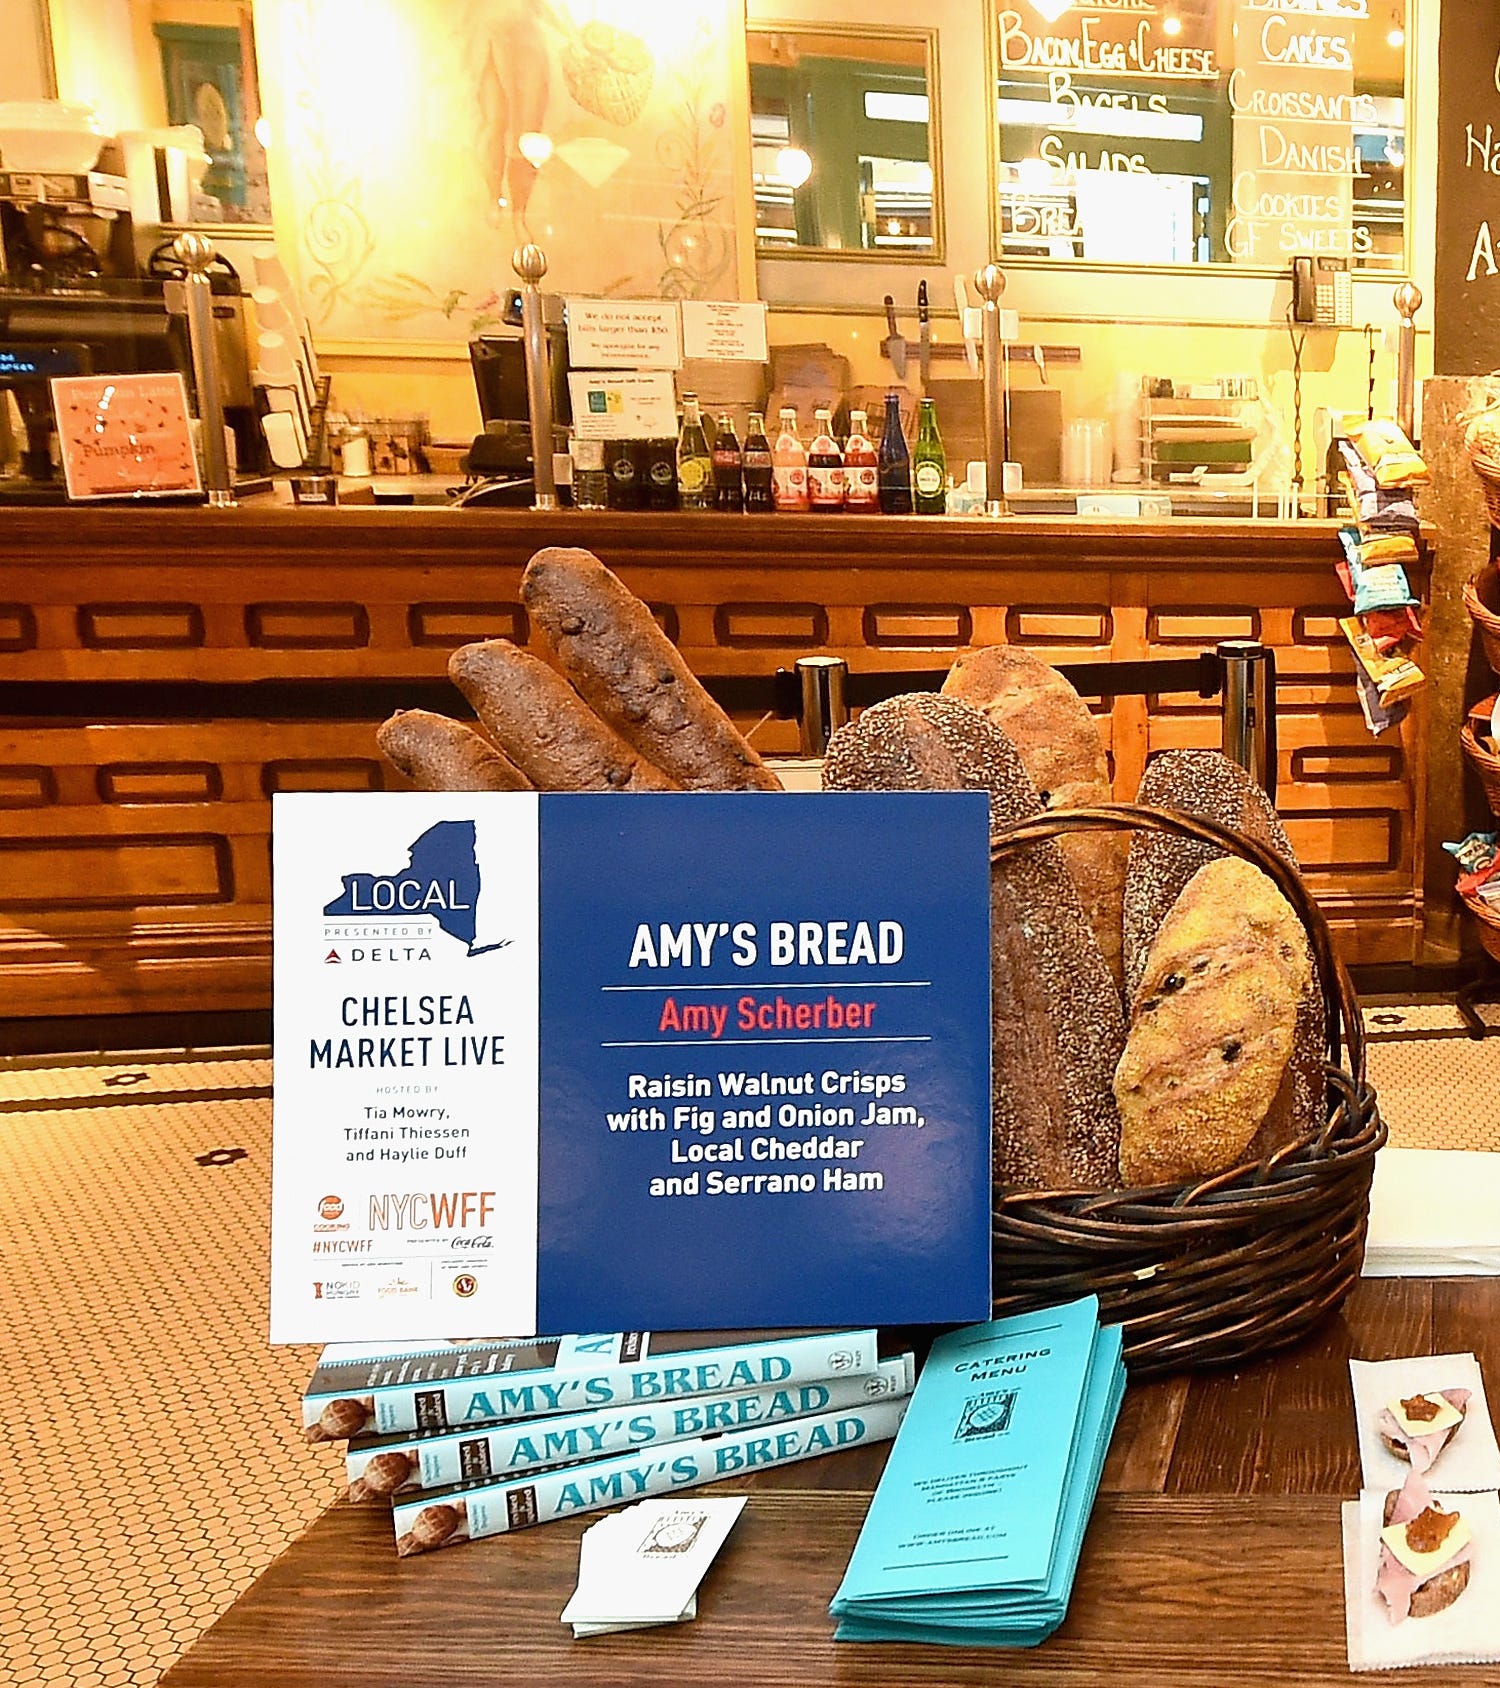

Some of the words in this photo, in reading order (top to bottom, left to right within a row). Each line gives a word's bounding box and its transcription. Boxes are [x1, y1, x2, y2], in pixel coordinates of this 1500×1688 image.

[1137, 20, 1220, 75] CHEESE
[1262, 16, 1352, 64] CAKES
[1229, 69, 1378, 123] CROISSANTS
[1259, 125, 1363, 174] DANISH
[1232, 171, 1343, 221] COOKIES
[1279, 221, 1373, 253] SWEETS
[351, 880, 470, 912] LOCAL
[324, 927, 410, 937] PRESENTED
[417, 927, 433, 936] BY
[628, 922, 758, 968] AMY'S
[770, 920, 905, 966] BREAD
[351, 948, 432, 962] DELTA
[341, 994, 475, 1027] CHELSEA
[659, 997, 729, 1038] Amy
[737, 995, 876, 1031] Scherber
[309, 1037, 433, 1069] MARKET
[443, 1035, 505, 1066] LIVE
[376, 1086, 421, 1095] HOSTED
[425, 1085, 439, 1094] BY
[628, 1073, 711, 1099] Raisin
[718, 1072, 815, 1097] Walnut
[820, 1070, 906, 1098] Crisps
[364, 1106, 387, 1119] Tia
[393, 1106, 450, 1120] Mowry,
[606, 1108, 665, 1132] with
[673, 1107, 714, 1135] Fig
[721, 1105, 771, 1129] and
[778, 1104, 855, 1129] Onion
[860, 1102, 925, 1129] Jam,
[343, 1127, 395, 1141] Tiffani
[400, 1126, 470, 1139] Thiessen
[670, 1138, 744, 1163] Local
[751, 1136, 865, 1161] Cheddar
[346, 1149, 375, 1162] and
[380, 1147, 429, 1163] Haylie
[434, 1146, 467, 1160] Duff
[649, 1171, 699, 1197] and
[706, 1170, 816, 1195] Serrano
[823, 1168, 884, 1191] Ham
[369, 1191, 497, 1231] NYCWFF
[313, 1239, 374, 1253] #NYCWFF
[954, 1348, 1052, 1374] CATERING
[970, 1364, 1028, 1383] MENU
[463, 1376, 615, 1421] AMY'S
[631, 1355, 792, 1400] BREAD
[508, 1421, 657, 1466] AMY'S
[672, 1385, 831, 1435] BREAD
[552, 1454, 701, 1513] AMY'S
[714, 1416, 867, 1475] BREAD
